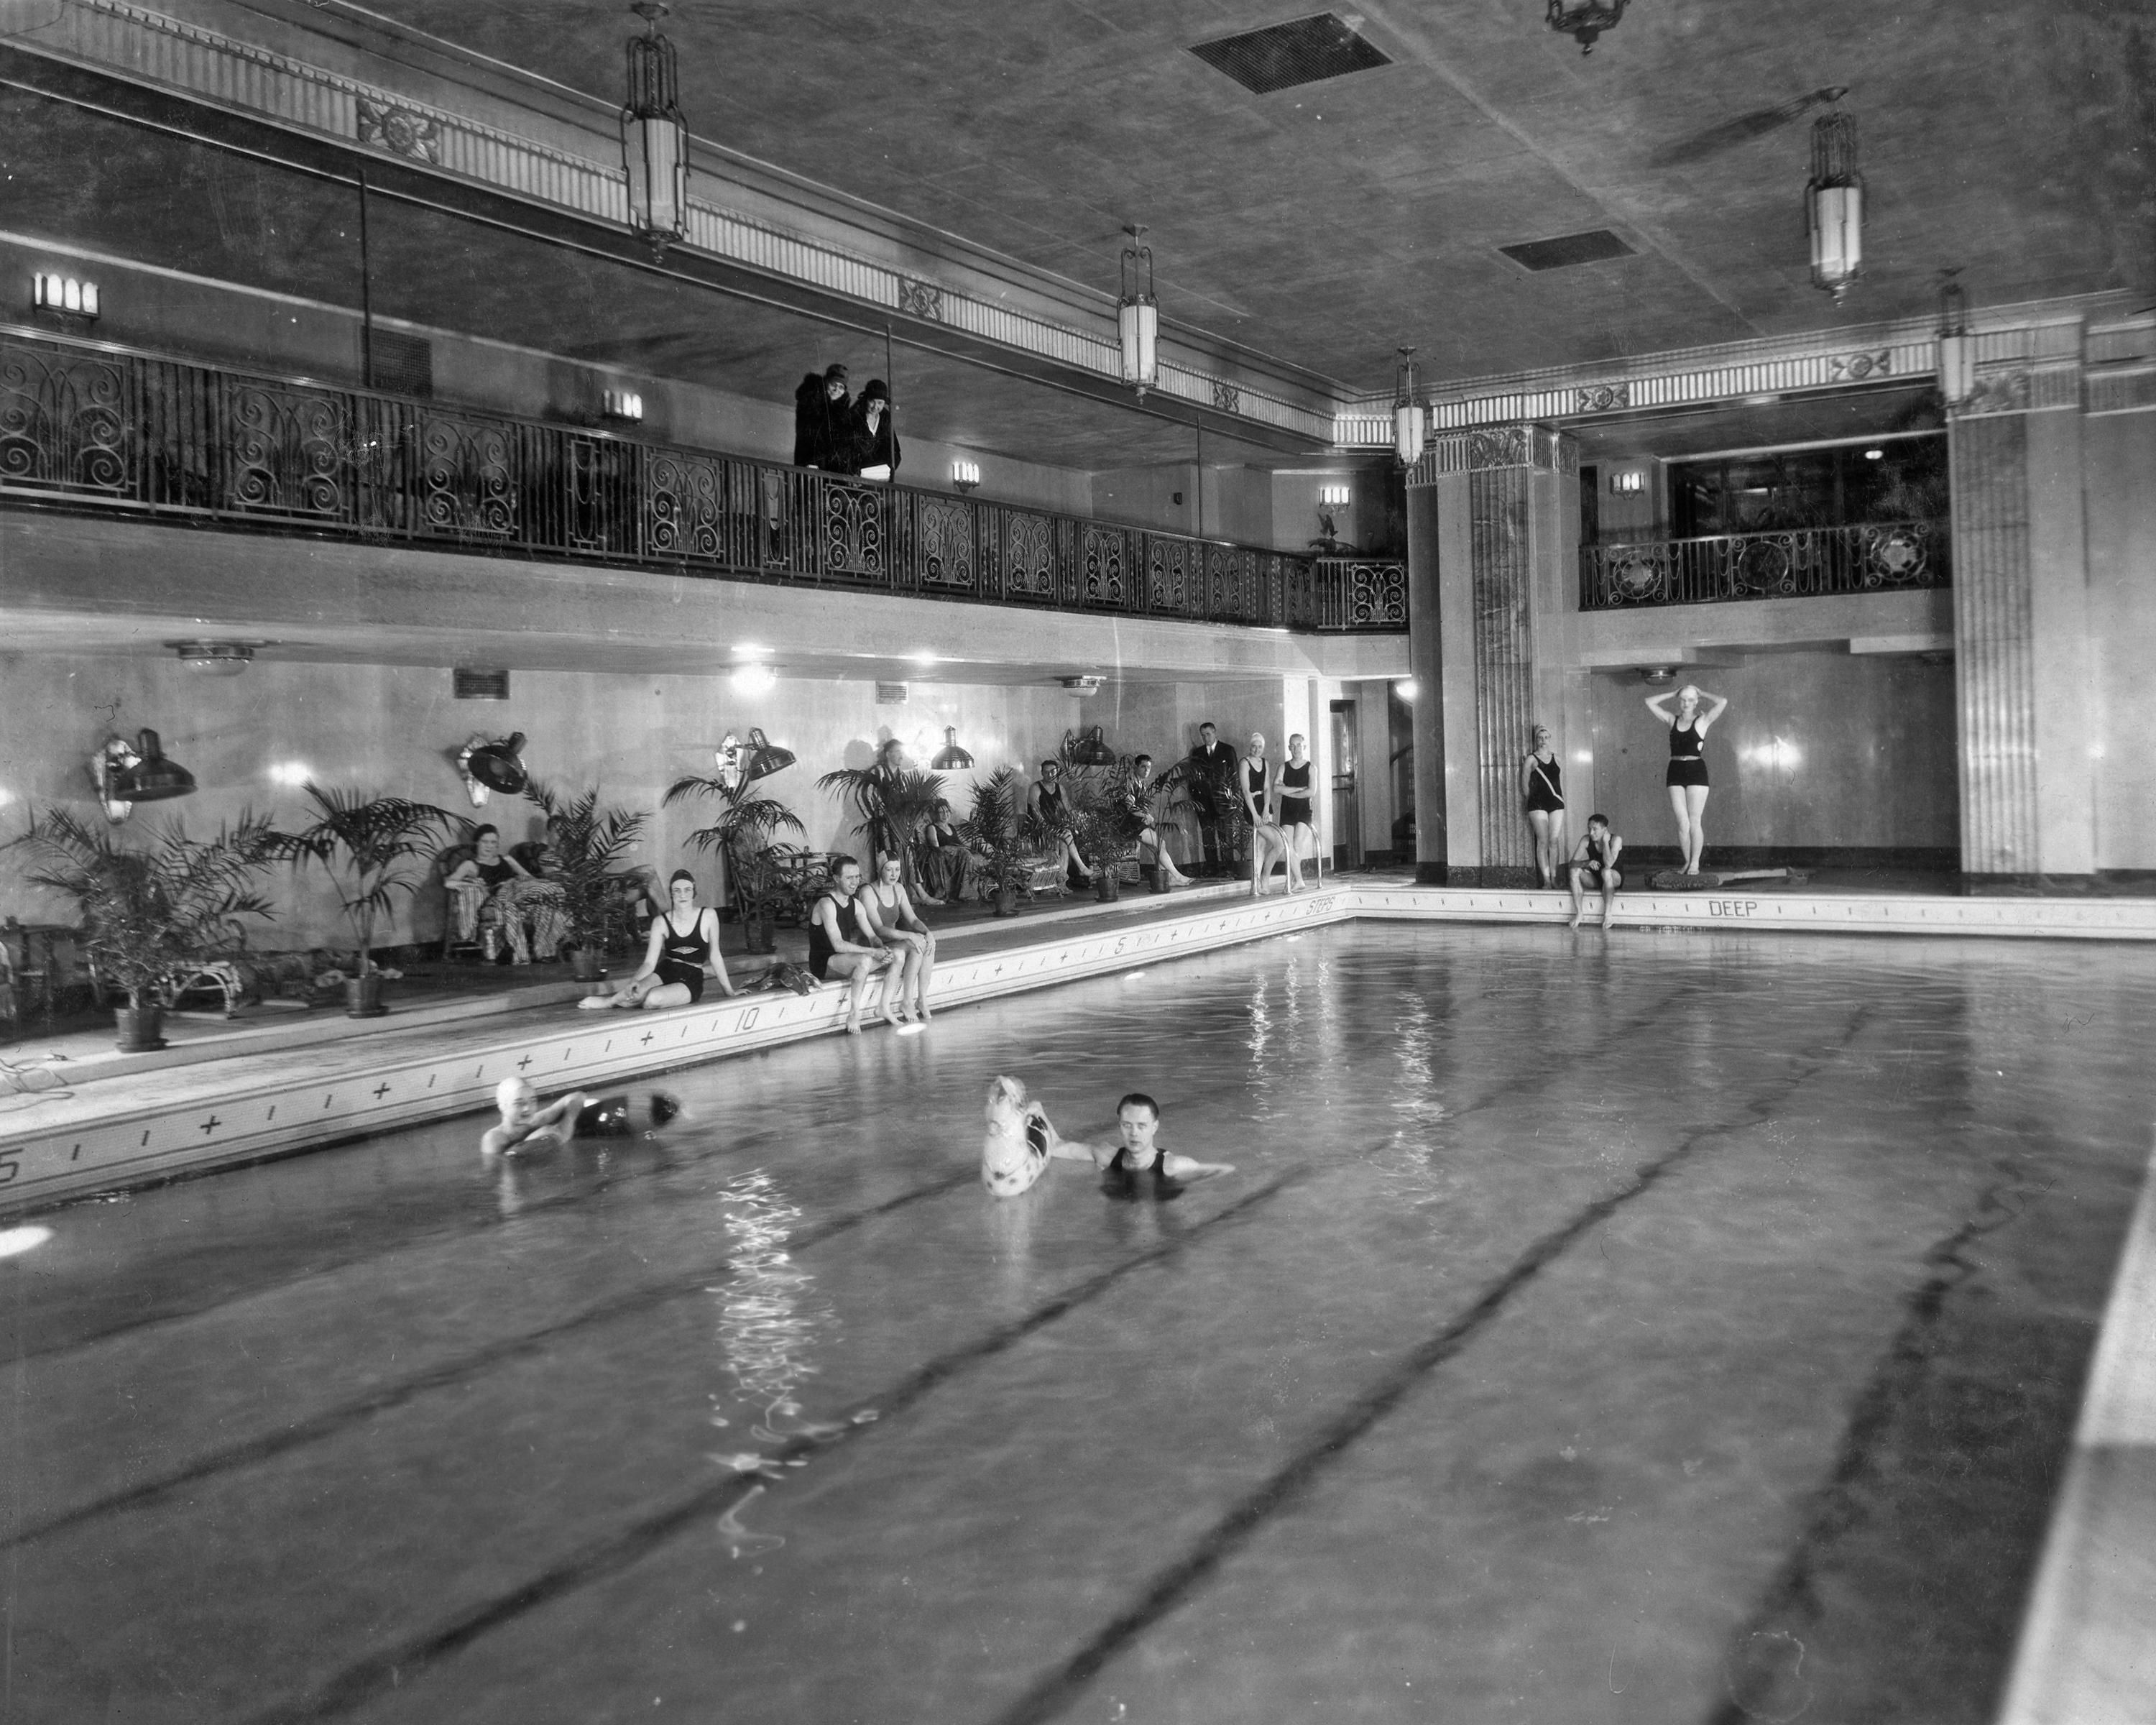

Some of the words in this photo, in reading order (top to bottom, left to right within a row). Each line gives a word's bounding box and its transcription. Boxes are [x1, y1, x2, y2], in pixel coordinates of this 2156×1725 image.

[1306, 896, 1335, 915] STEPS
[1709, 901, 1758, 916] DEEP
[1115, 936, 1128, 954] 5
[734, 1007, 760, 1032] 10
